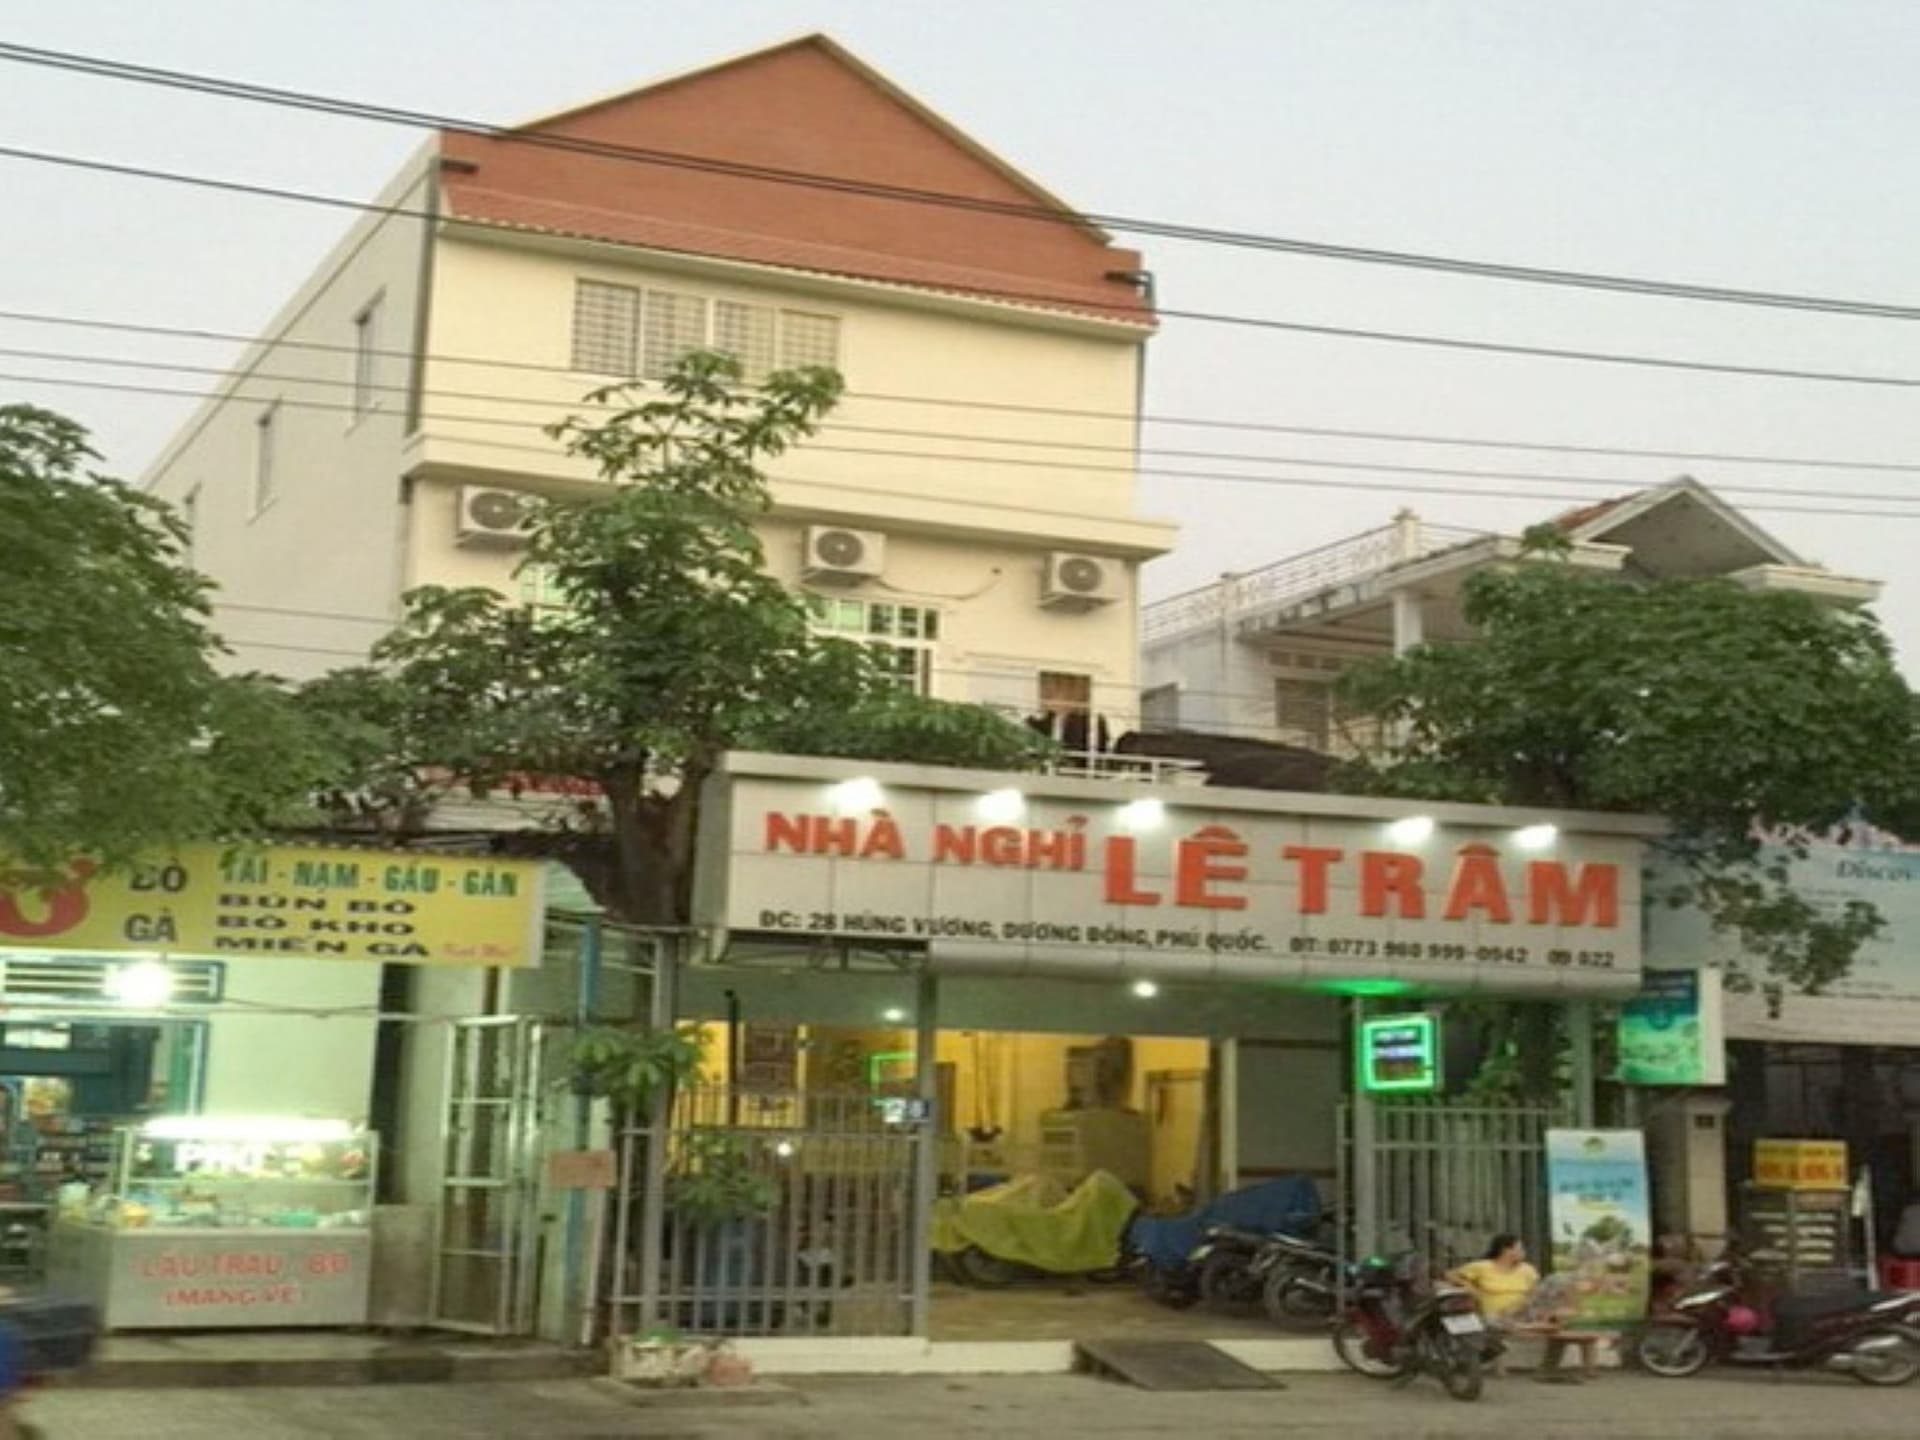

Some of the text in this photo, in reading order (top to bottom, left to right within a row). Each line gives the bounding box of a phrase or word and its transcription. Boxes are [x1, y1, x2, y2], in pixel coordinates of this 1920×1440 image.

[765, 808, 905, 858] NHÀ
[1104, 825, 1248, 909] LÊ
[1282, 842, 1619, 928] TRÂM
